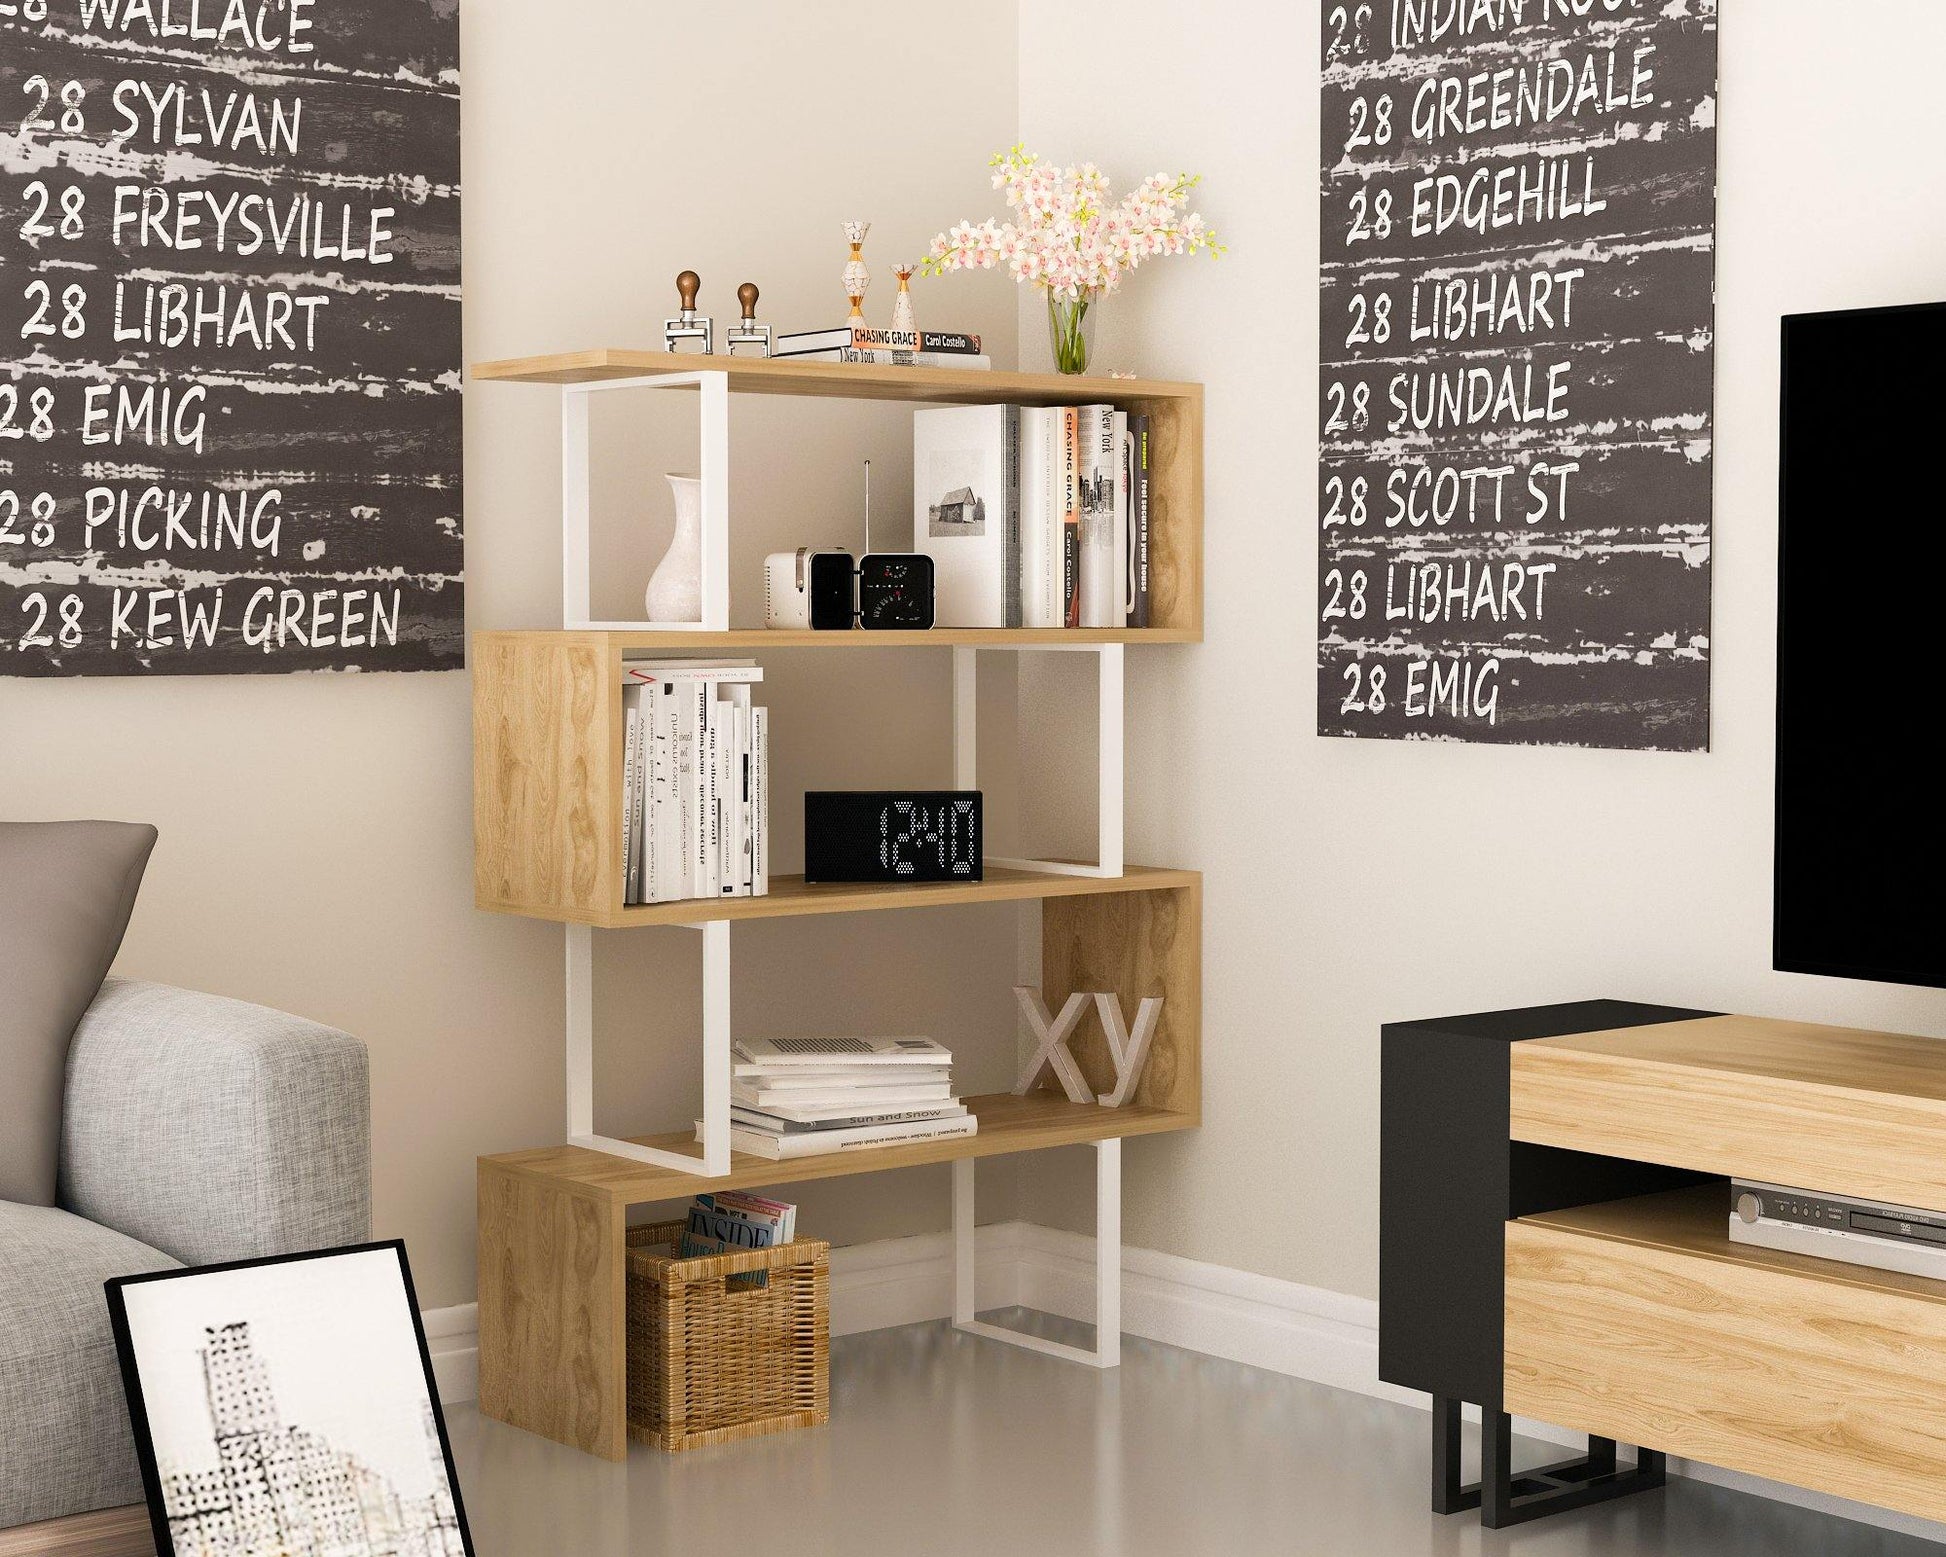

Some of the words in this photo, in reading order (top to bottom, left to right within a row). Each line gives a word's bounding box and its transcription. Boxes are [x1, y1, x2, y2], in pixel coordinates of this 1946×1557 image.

[79, 0, 315, 53] WALLACE
[19, 75, 86, 133] 28
[111, 79, 302, 156] SYLVAN
[1346, 93, 1393, 153] 28
[1410, 45, 1657, 145] GREENDALE
[19, 181, 85, 240] 28
[112, 186, 396, 264] FREYSVILLE
[1346, 188, 1393, 246] 28
[1411, 155, 1607, 238] EDGEHILL
[20, 280, 87, 340] 28
[112, 282, 330, 351] LIBHART
[855, 328, 890, 345] CHASING
[891, 330, 918, 346] GRACE
[925, 334, 941, 347] Carol
[942, 335, 966, 349] Costello
[1345, 292, 1392, 348] 28
[1409, 268, 1585, 342] LIBHART
[844, 348, 859, 363] New
[859, 350, 876, 364] York
[0, 384, 55, 442] 28
[82, 385, 207, 455] EMIG
[1102, 410, 1113, 430] New
[1324, 381, 1370, 435] 28
[1387, 361, 1571, 432] SUNDALE
[1102, 432, 1114, 453] York
[0, 490, 57, 547] 28
[85, 487, 282, 557] PICKING
[1323, 476, 1368, 530] 28
[1385, 465, 1515, 528] SCOTT
[1526, 462, 1579, 524] ST
[18, 592, 85, 652] 28
[110, 588, 223, 650] KEW
[242, 587, 401, 654] GREEN
[1321, 568, 1368, 622] 28
[1385, 561, 1556, 623] LIBHART
[1340, 664, 1386, 715] 28
[1404, 659, 1499, 726] EMIG
[627, 723, 635, 751] love
[633, 798, 641, 828] Sun
[637, 717, 645, 760] Snow
[880, 801, 974, 874] 12:40
[877, 1113, 901, 1121] and
[905, 1110, 941, 1119] Snow
